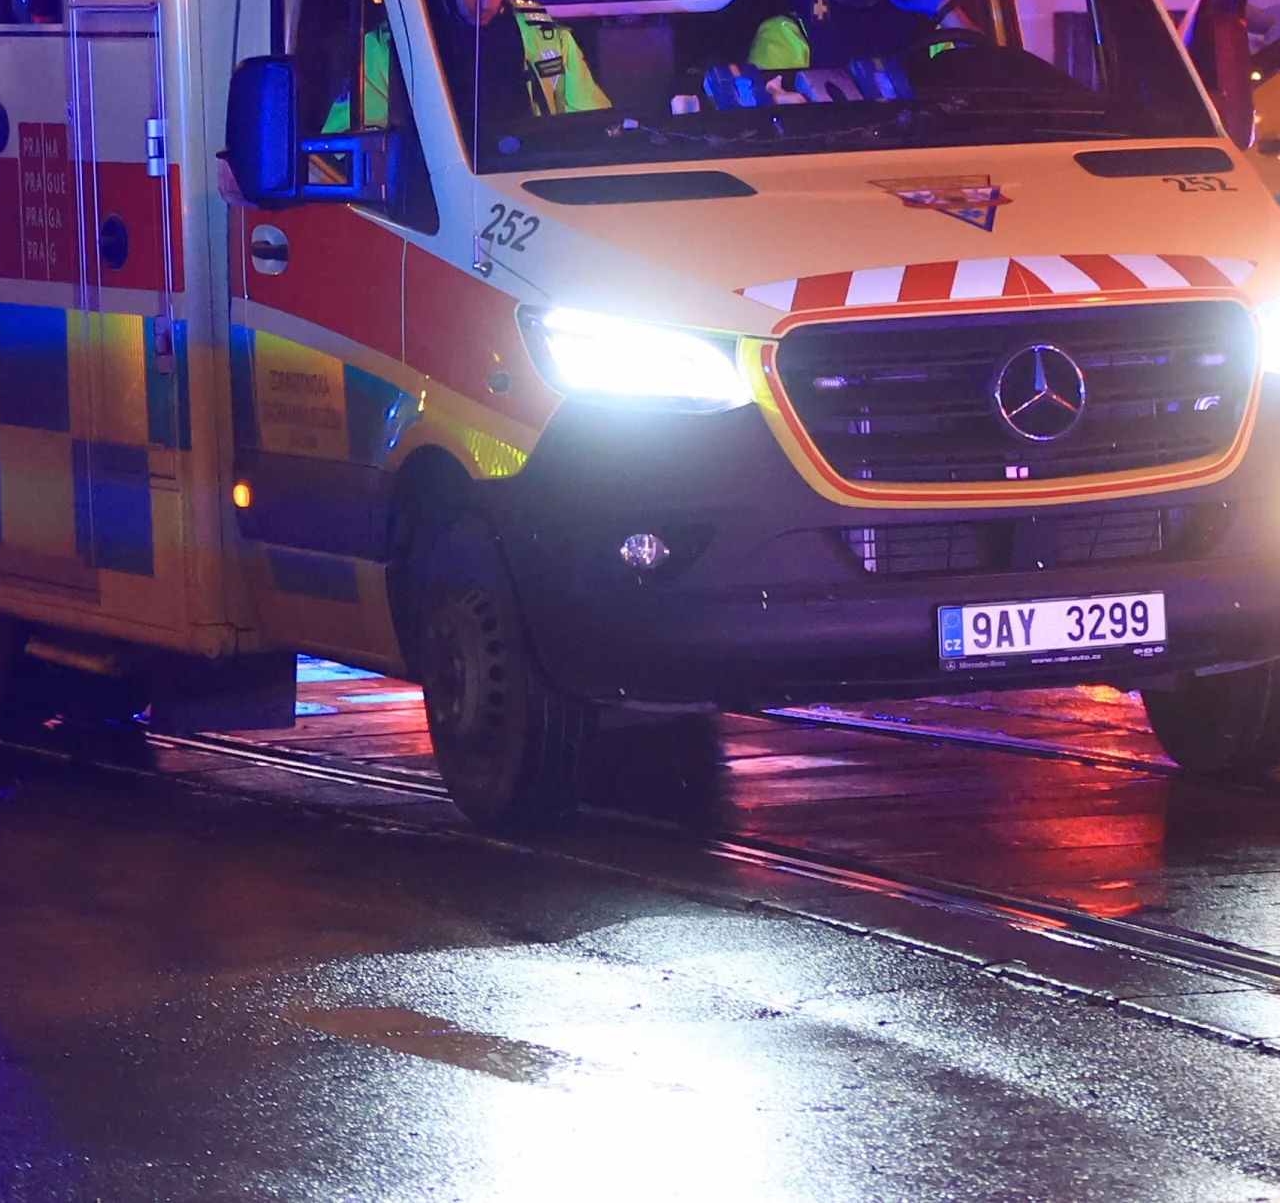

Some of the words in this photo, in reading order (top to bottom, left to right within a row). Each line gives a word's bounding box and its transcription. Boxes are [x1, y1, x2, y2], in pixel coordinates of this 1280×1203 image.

[23, 137, 59, 158] PRAHA
[24, 172, 66, 194] PRAGUE
[1162, 176, 1238, 192] 252
[26, 207, 62, 229] PRAGA
[480, 203, 540, 252] 252
[28, 241, 57, 264] PRAG
[972, 608, 1035, 649] 9AY
[1066, 600, 1149, 641] 3299
[944, 638, 962, 651] CZ
